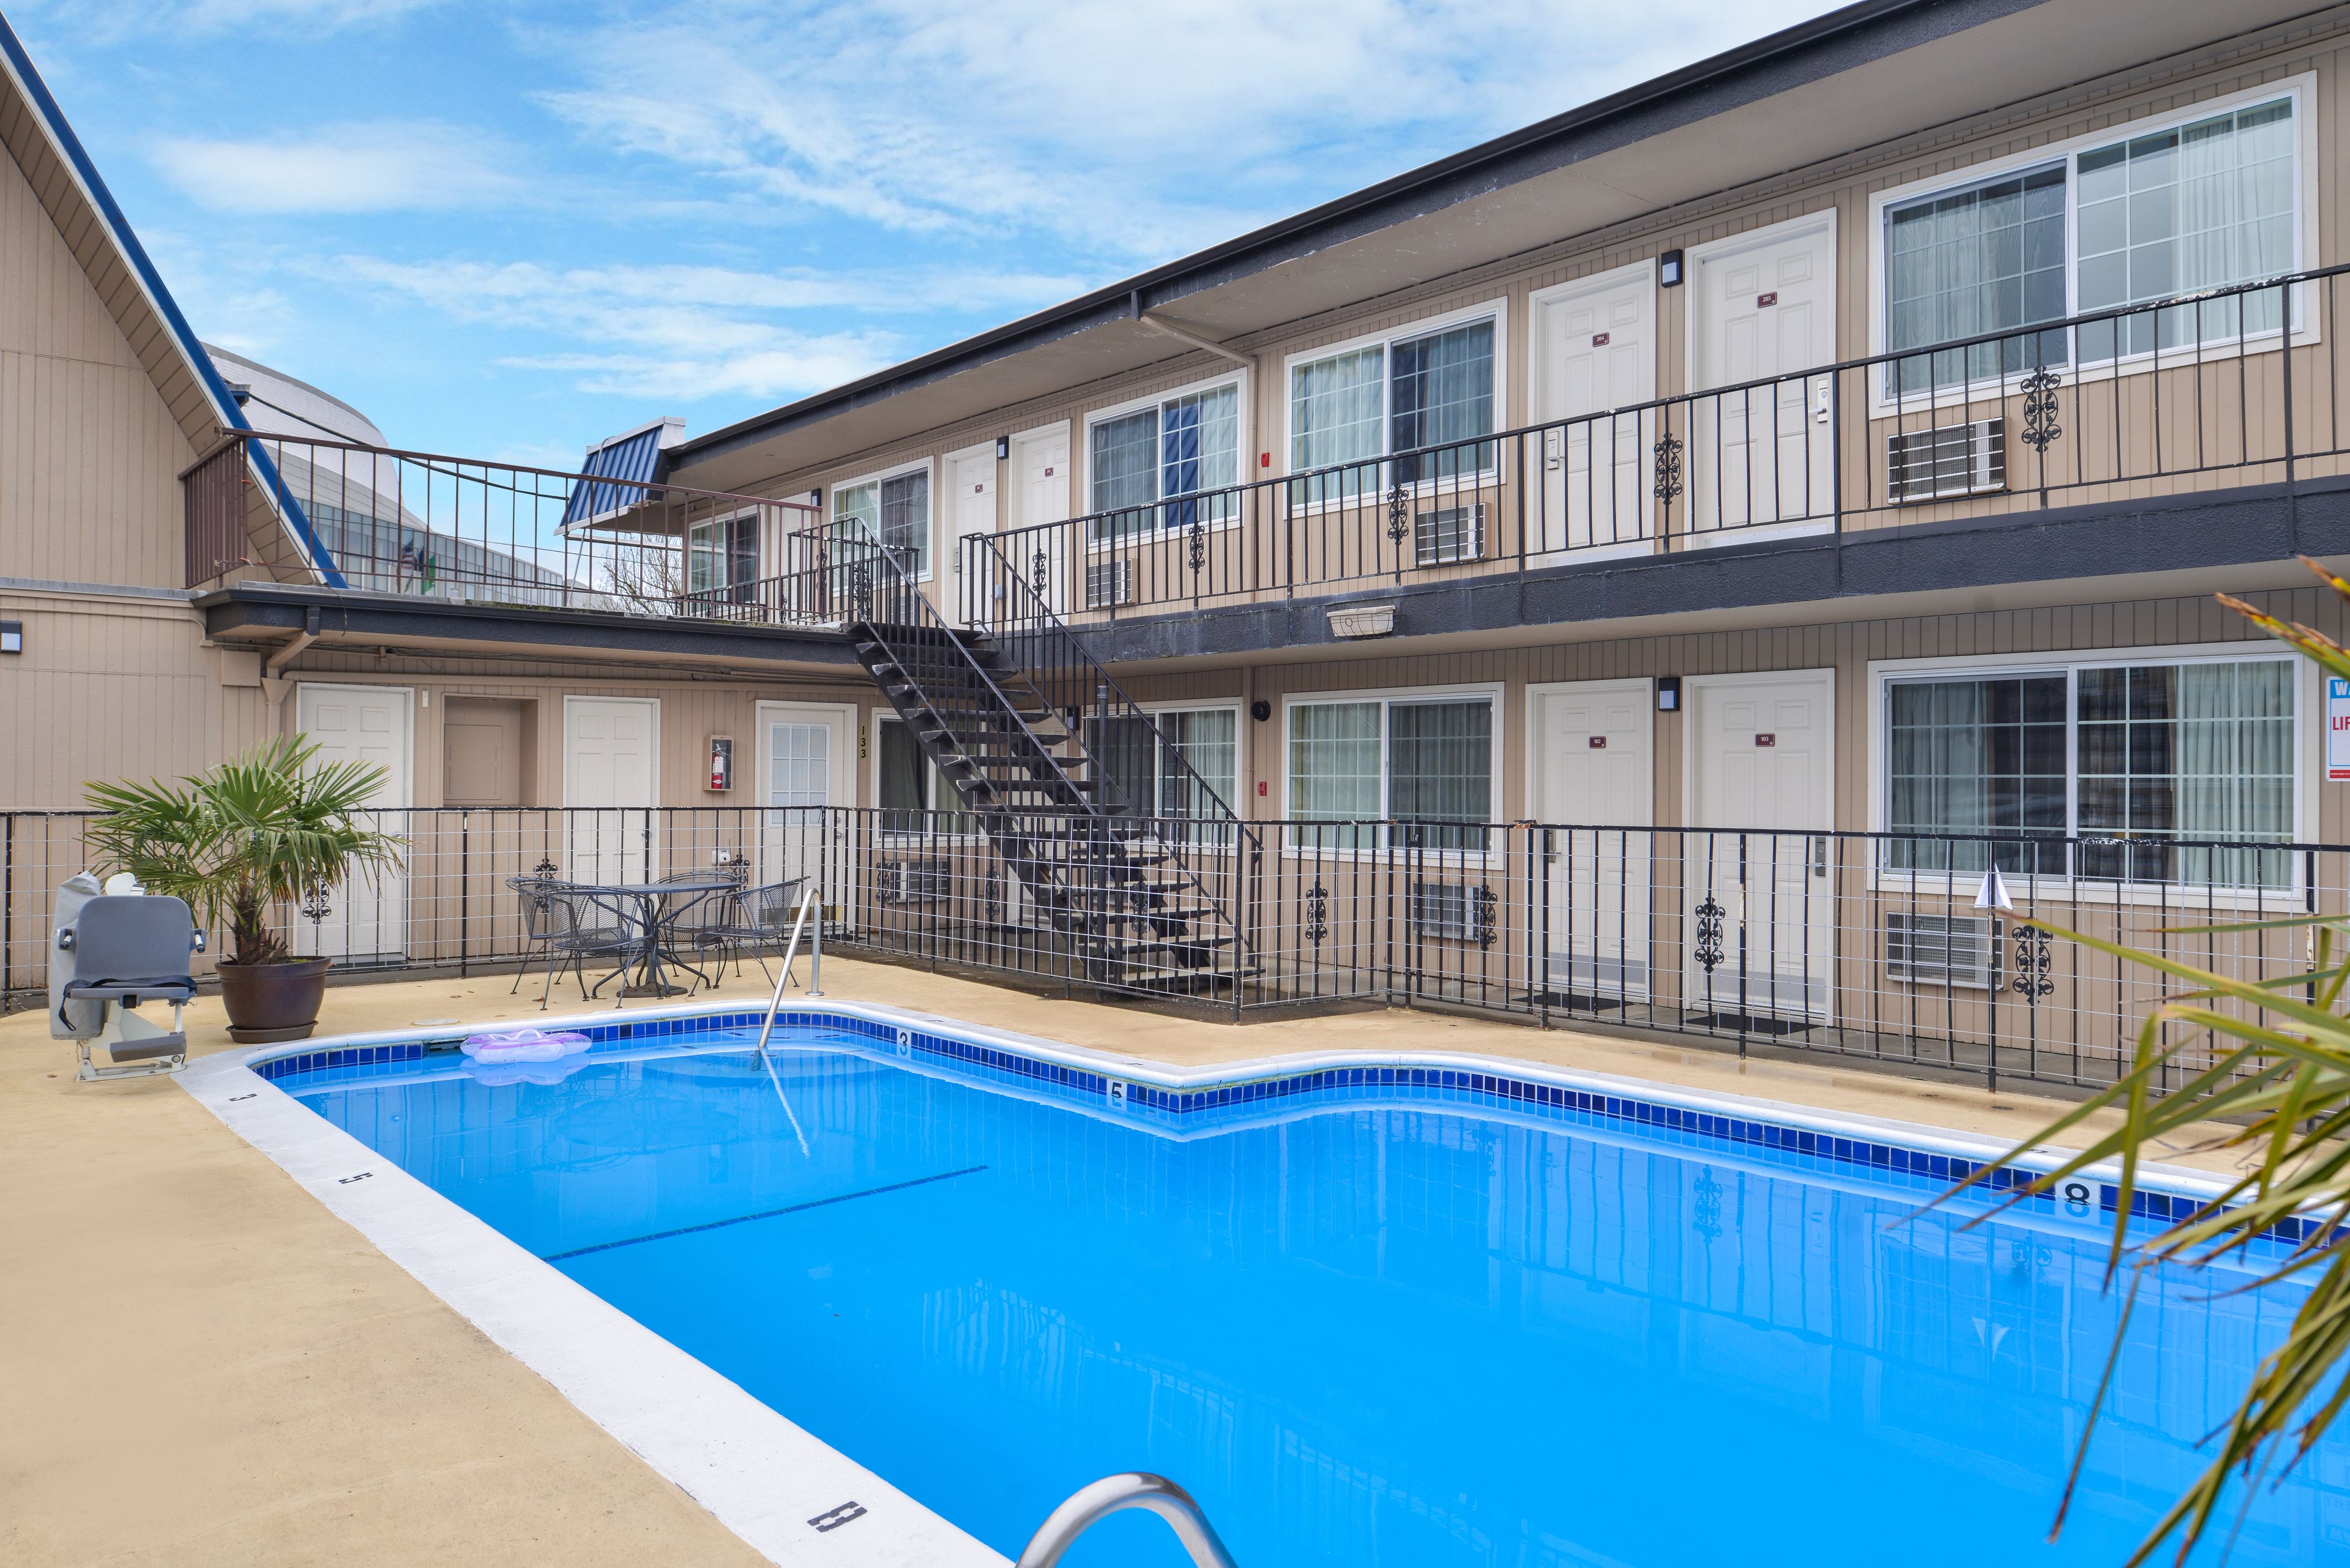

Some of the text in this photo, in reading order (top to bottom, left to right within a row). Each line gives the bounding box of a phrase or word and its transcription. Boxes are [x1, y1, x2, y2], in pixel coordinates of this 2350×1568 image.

[2335, 682, 2350, 696] W
[900, 1032, 908, 1047] 3
[1111, 1081, 1122, 1098] 5
[338, 1173, 373, 1184] 5
[807, 1501, 868, 1533] 8
